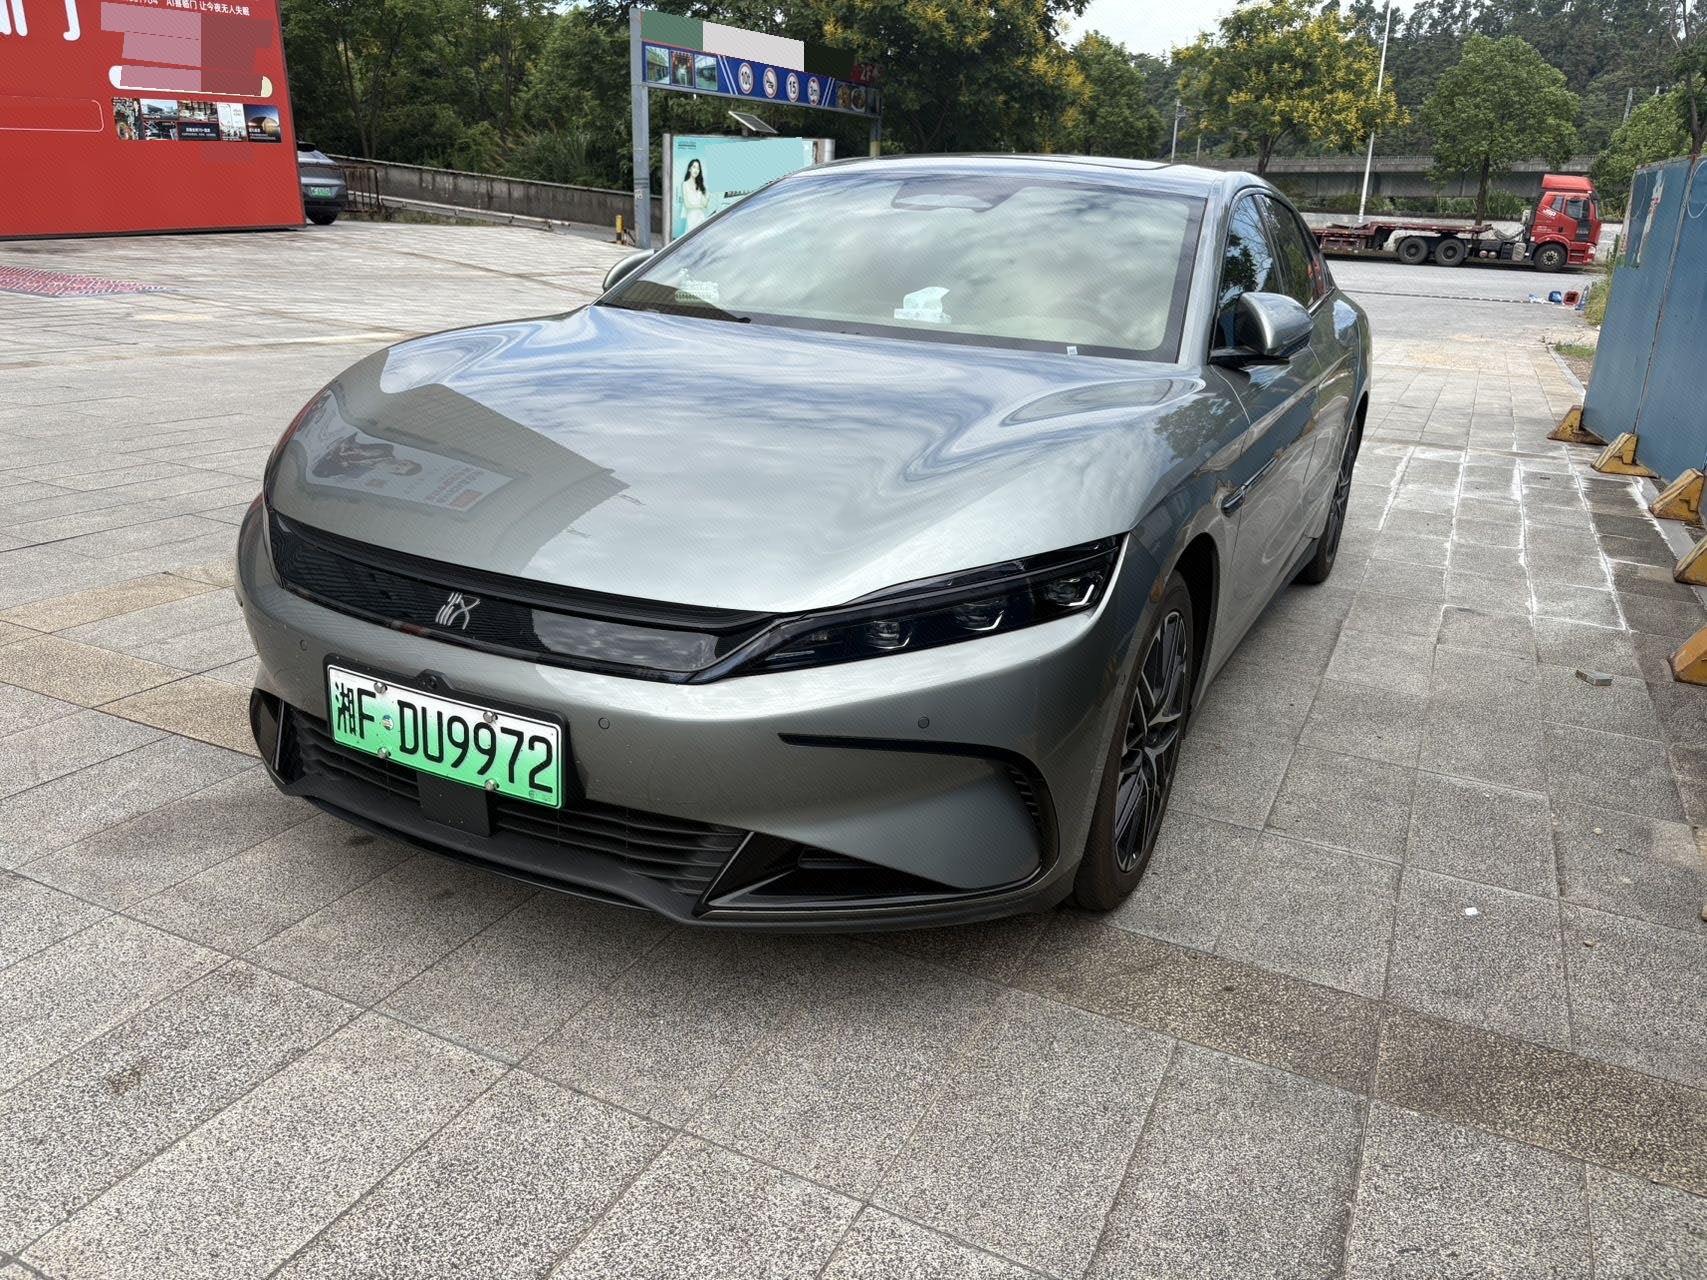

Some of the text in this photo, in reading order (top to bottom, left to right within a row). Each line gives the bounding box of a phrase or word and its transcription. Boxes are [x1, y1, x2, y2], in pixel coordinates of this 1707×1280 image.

[199, 1, 250, 16] 让今夜无人失眠
[789, 80, 797, 95] 15
